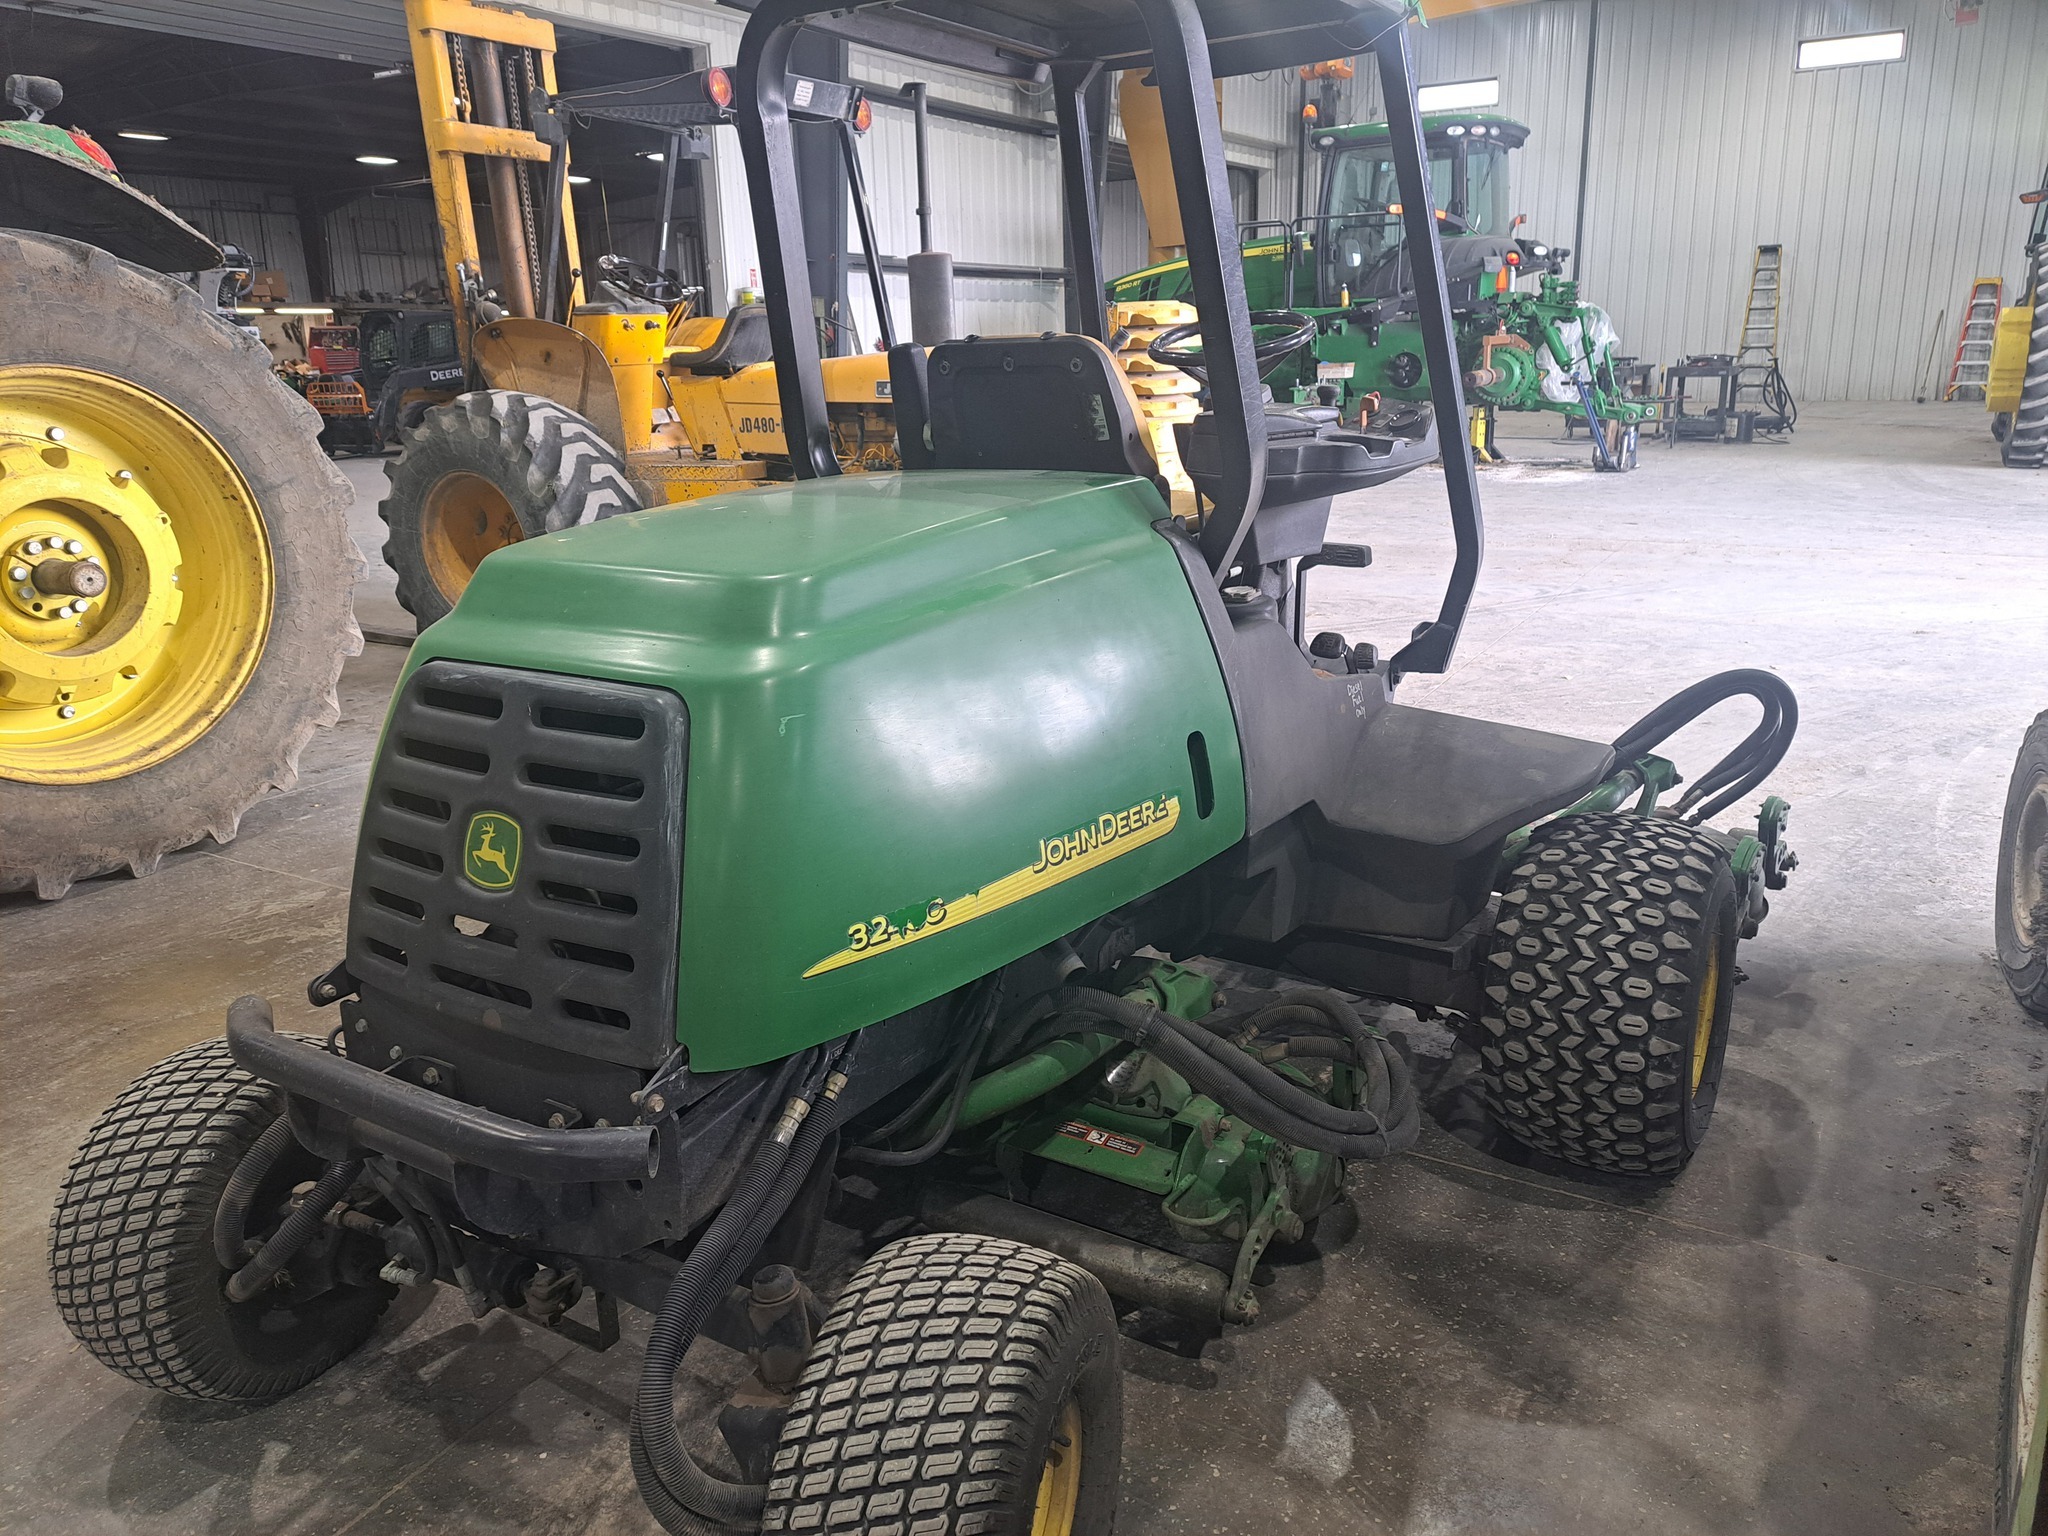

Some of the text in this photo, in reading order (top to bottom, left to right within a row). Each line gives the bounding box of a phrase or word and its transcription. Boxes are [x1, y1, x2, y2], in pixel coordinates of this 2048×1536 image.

[1259, 247, 1279, 255] JOHN
[430, 368, 464, 381] DEERE
[738, 416, 785, 434] JD480-
[1033, 794, 1169, 874] JOHN DEERE
[847, 896, 948, 951] 32C
